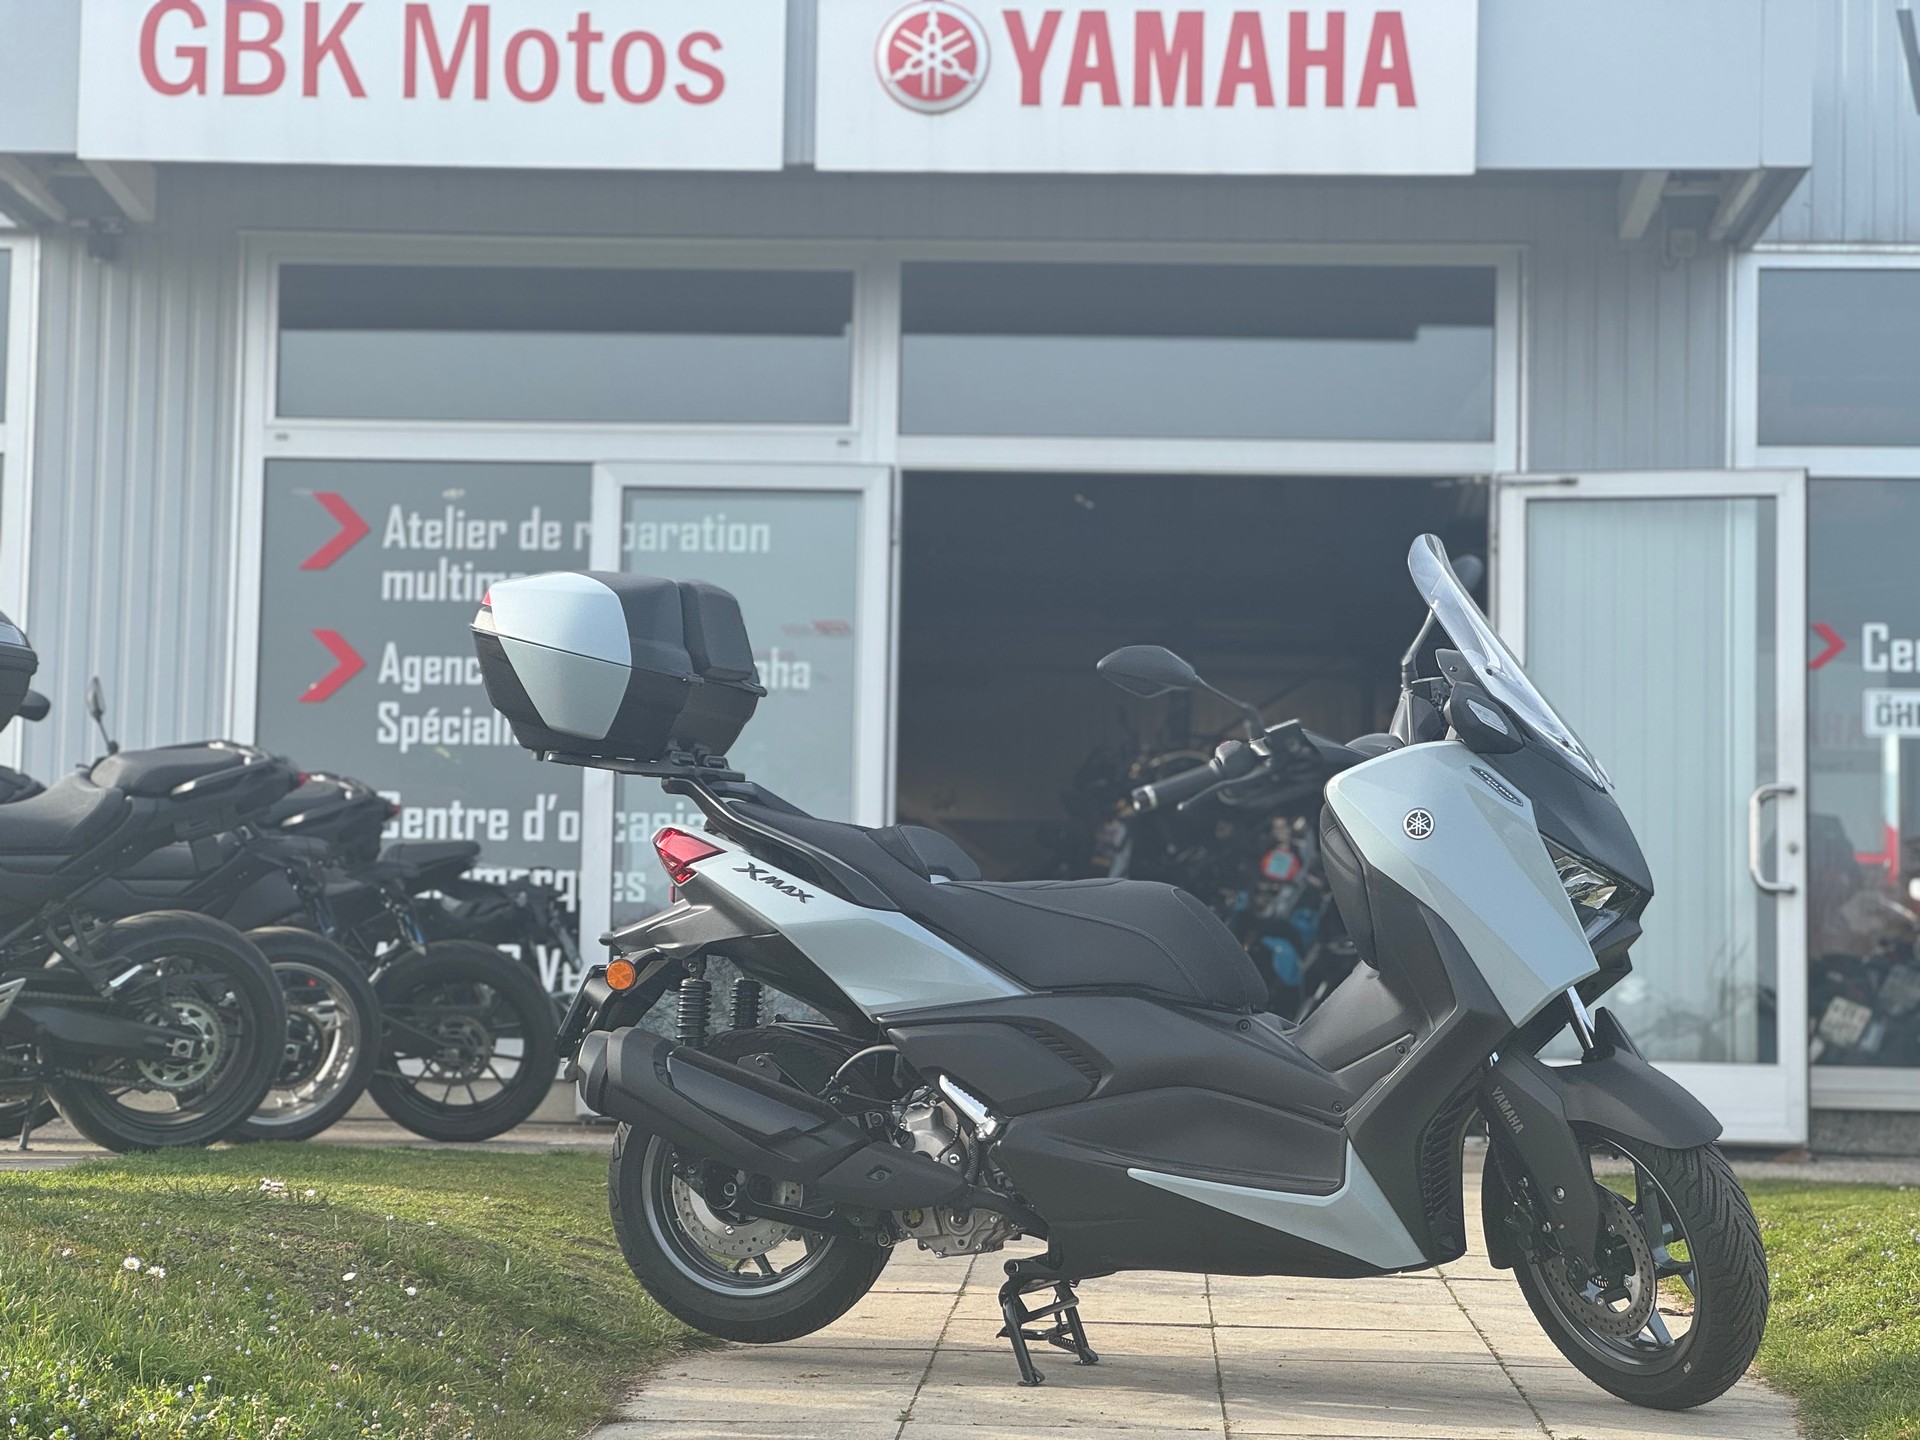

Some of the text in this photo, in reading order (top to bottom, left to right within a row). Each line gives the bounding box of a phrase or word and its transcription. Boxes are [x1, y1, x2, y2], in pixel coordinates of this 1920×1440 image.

[138, 0, 727, 105] GBK Motos
[1003, 10, 1418, 108] YAMAHA
[382, 504, 508, 550] Atelier
[519, 506, 562, 551] de
[377, 641, 484, 694] Agenc
[376, 701, 521, 754] Spéciali
[1491, 1086, 1524, 1134] YAMAHA
